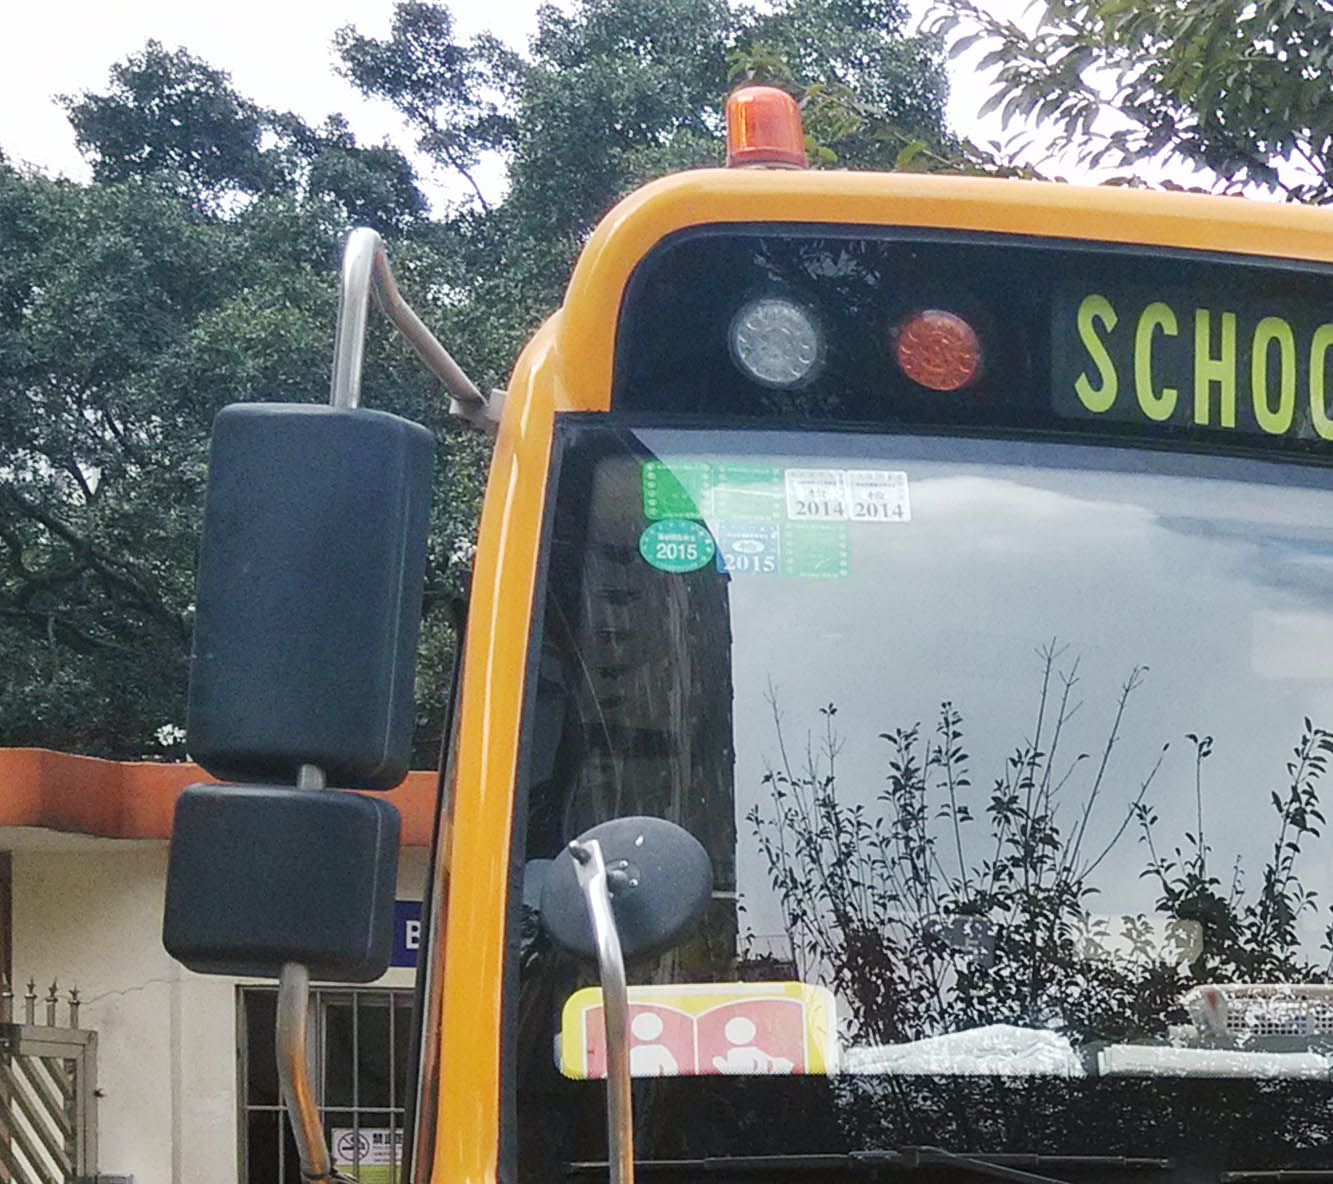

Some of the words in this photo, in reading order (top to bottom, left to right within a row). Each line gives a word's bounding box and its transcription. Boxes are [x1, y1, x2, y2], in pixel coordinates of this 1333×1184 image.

[796, 500, 845, 517] 2014
[855, 501, 904, 519] 2014
[656, 542, 698, 560] 2015
[724, 553, 775, 572] 2015
